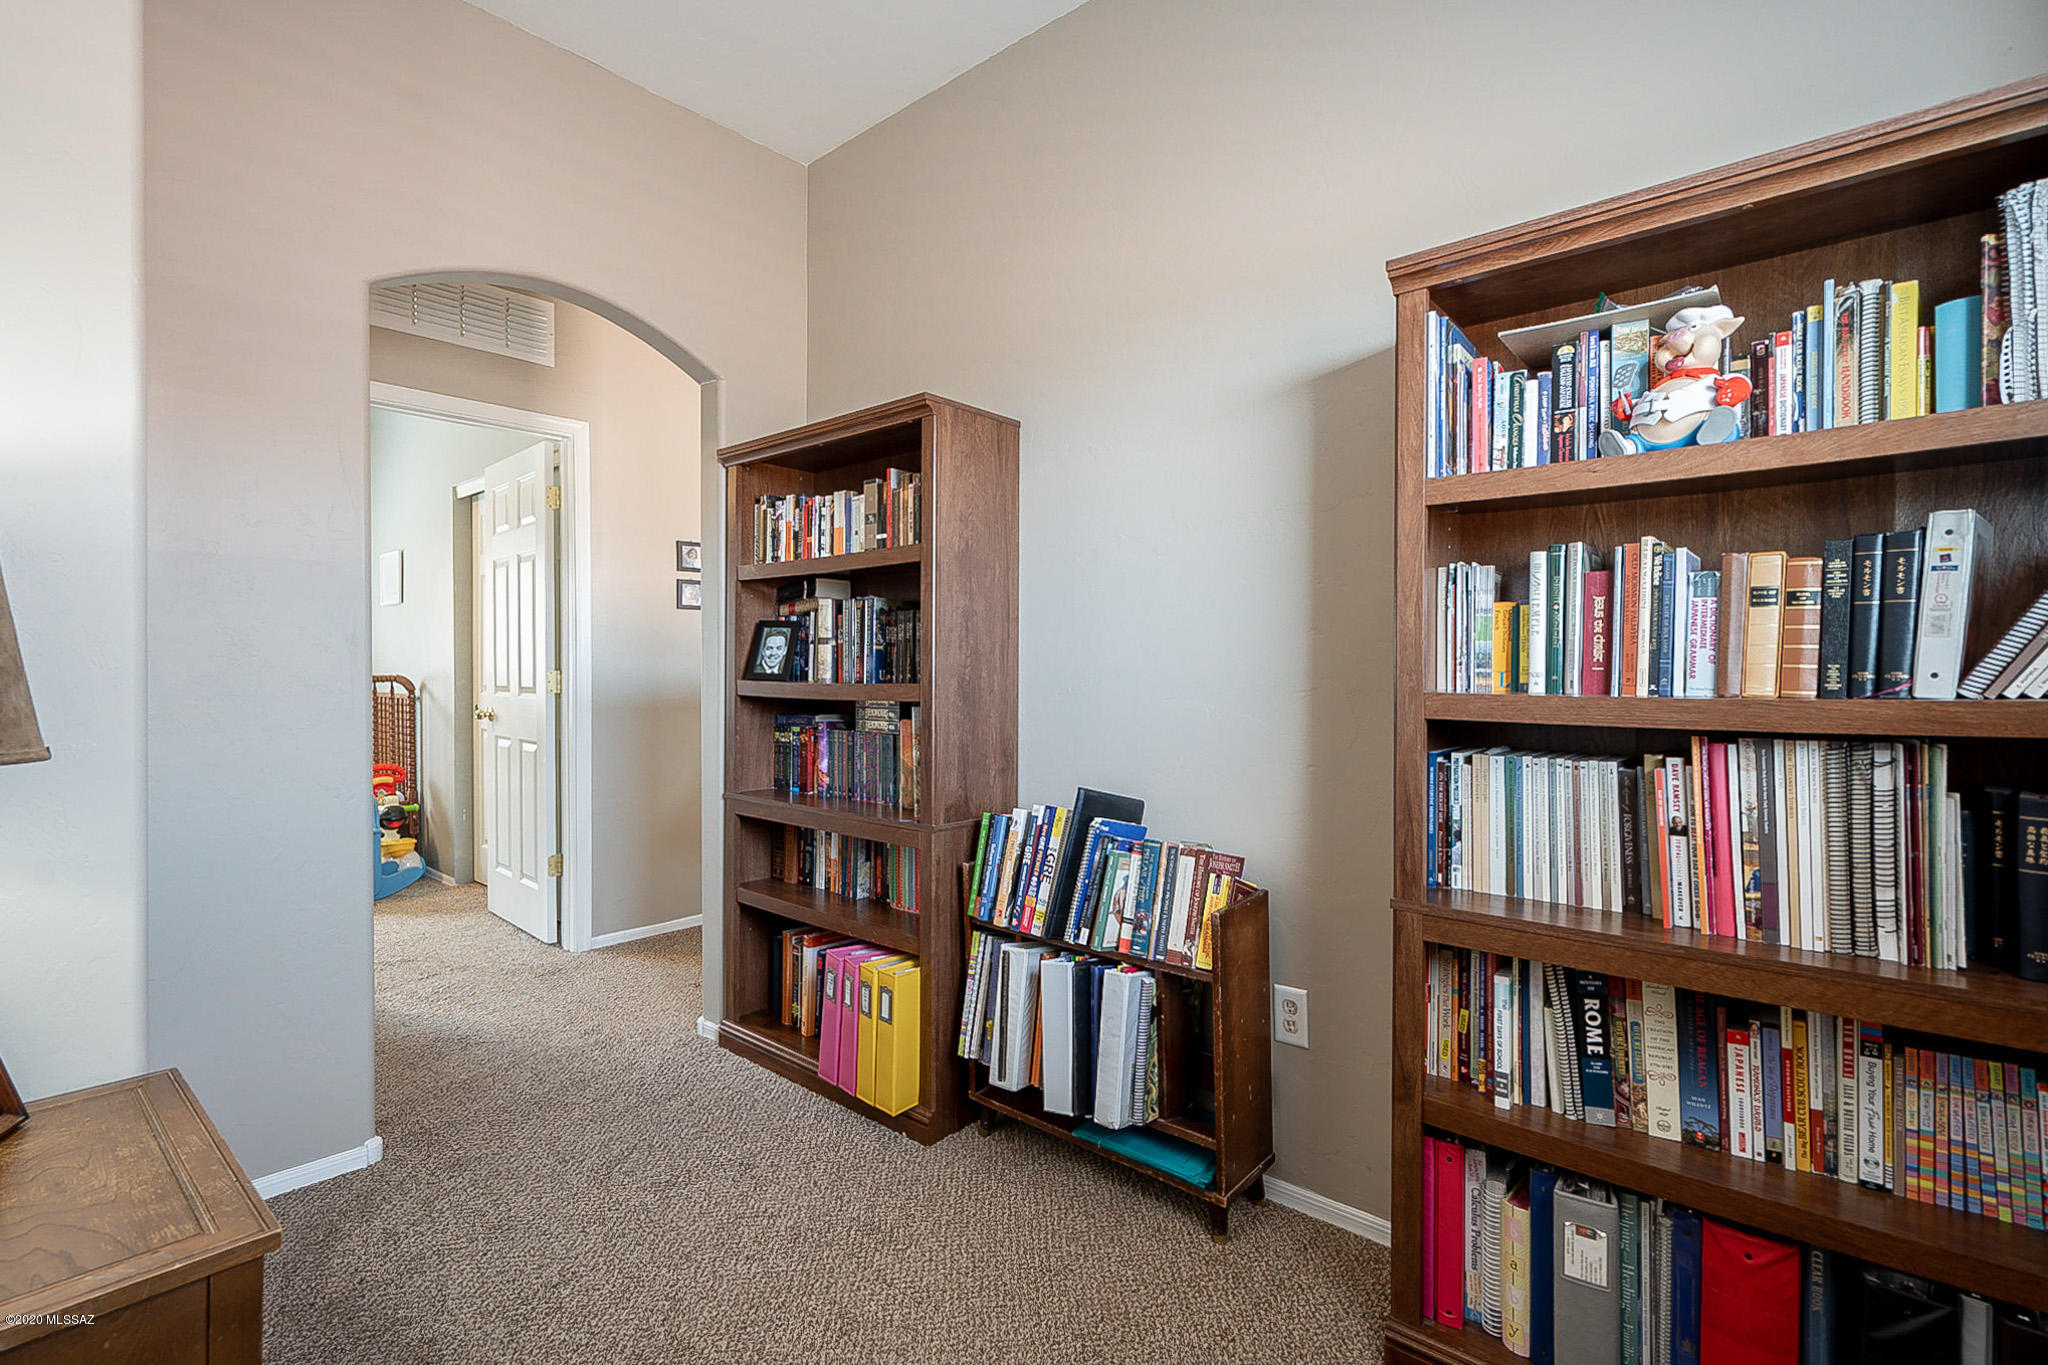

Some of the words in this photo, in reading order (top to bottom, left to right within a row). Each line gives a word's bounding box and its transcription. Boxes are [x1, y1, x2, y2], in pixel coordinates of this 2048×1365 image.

[1841, 365, 1852, 419] HANDBOOK
[1690, 600, 1699, 636] JAPANESE
[1700, 600, 1708, 649] INTERMEDIATE
[1709, 607, 1718, 652] DICTIONARY
[1689, 639, 1698, 680] GRAMMAR
[1708, 654, 1717, 665] OF
[1670, 763, 1680, 781] DAVE
[1672, 784, 1682, 812] RAMSEY
[1023, 846, 1033, 865] GRE
[1042, 853, 1056, 885] GRE
[1442, 1008, 1451, 1029] Work
[1459, 1014, 1467, 1031] USED
[1583, 998, 1605, 1056] ROME
[1696, 1030, 1706, 1043] OF
[1696, 1046, 1709, 1089] REAGAN
[1734, 1047, 1746, 1094] JAPANESE
[1796, 1046, 1805, 1069] BOOK
[1752, 1064, 1762, 1103] RAMONA'S
[1797, 1070, 1806, 1098] SCOUT
[1865, 1061, 1877, 1087] Buying
[1797, 1099, 1806, 1116] CUB
[1869, 1089, 1877, 1106] Your
[1798, 1117, 1807, 1140] BEAR
[1864, 1107, 1880, 1129] First
[1867, 1131, 1876, 1153] Home
[1471, 1187, 1482, 1227] Calculus
[1620, 1202, 1636, 1251] Helping
[1471, 1228, 1482, 1271] Problems
[1621, 1264, 1636, 1313] Healing
[1810, 1285, 1824, 1311] BOOK
